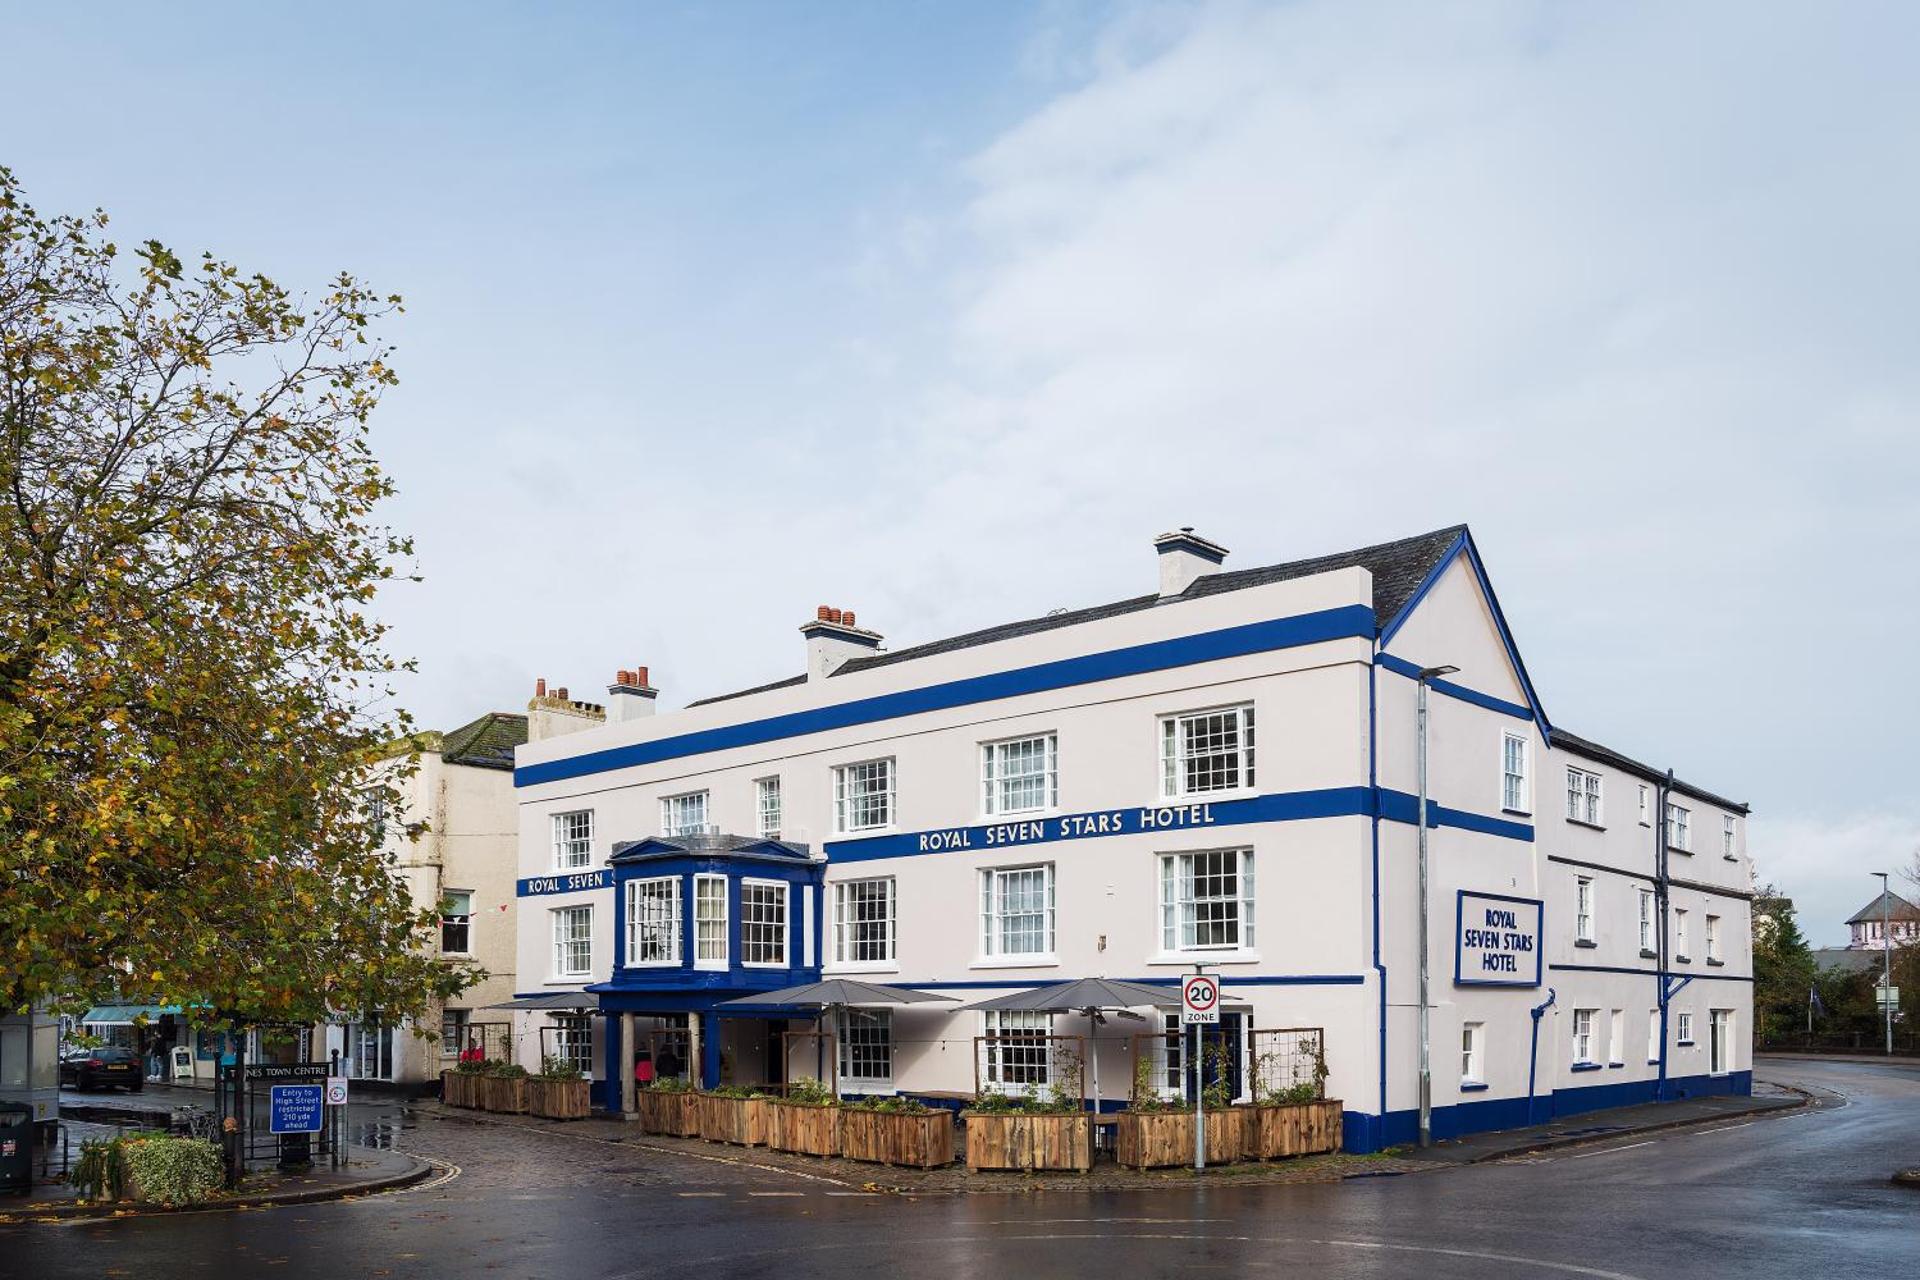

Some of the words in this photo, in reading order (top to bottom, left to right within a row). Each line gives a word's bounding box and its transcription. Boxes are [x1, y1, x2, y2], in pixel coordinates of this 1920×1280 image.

[920, 830, 971, 851] ROYAL
[986, 821, 1044, 845] SEVEN
[1060, 812, 1122, 837] STARS
[1140, 803, 1214, 829] HOTEL
[528, 878, 560, 893] ROYAL
[568, 872, 603, 889] SEVEN
[1485, 908, 1517, 929] ROYAL
[1464, 929, 1500, 949] SEVEN
[1503, 932, 1533, 952] STARS
[1482, 952, 1517, 972] HOTEL
[1190, 986, 1213, 1002] 20
[1188, 1013, 1215, 1021] ZONE
[265, 1066, 292, 1076] TOWN
[294, 1066, 326, 1076] CENTRE
[282, 1089, 302, 1098] Entry
[275, 1098, 293, 1106] High
[297, 1113, 311, 1121] yds
[285, 1121, 308, 1129] ahead
